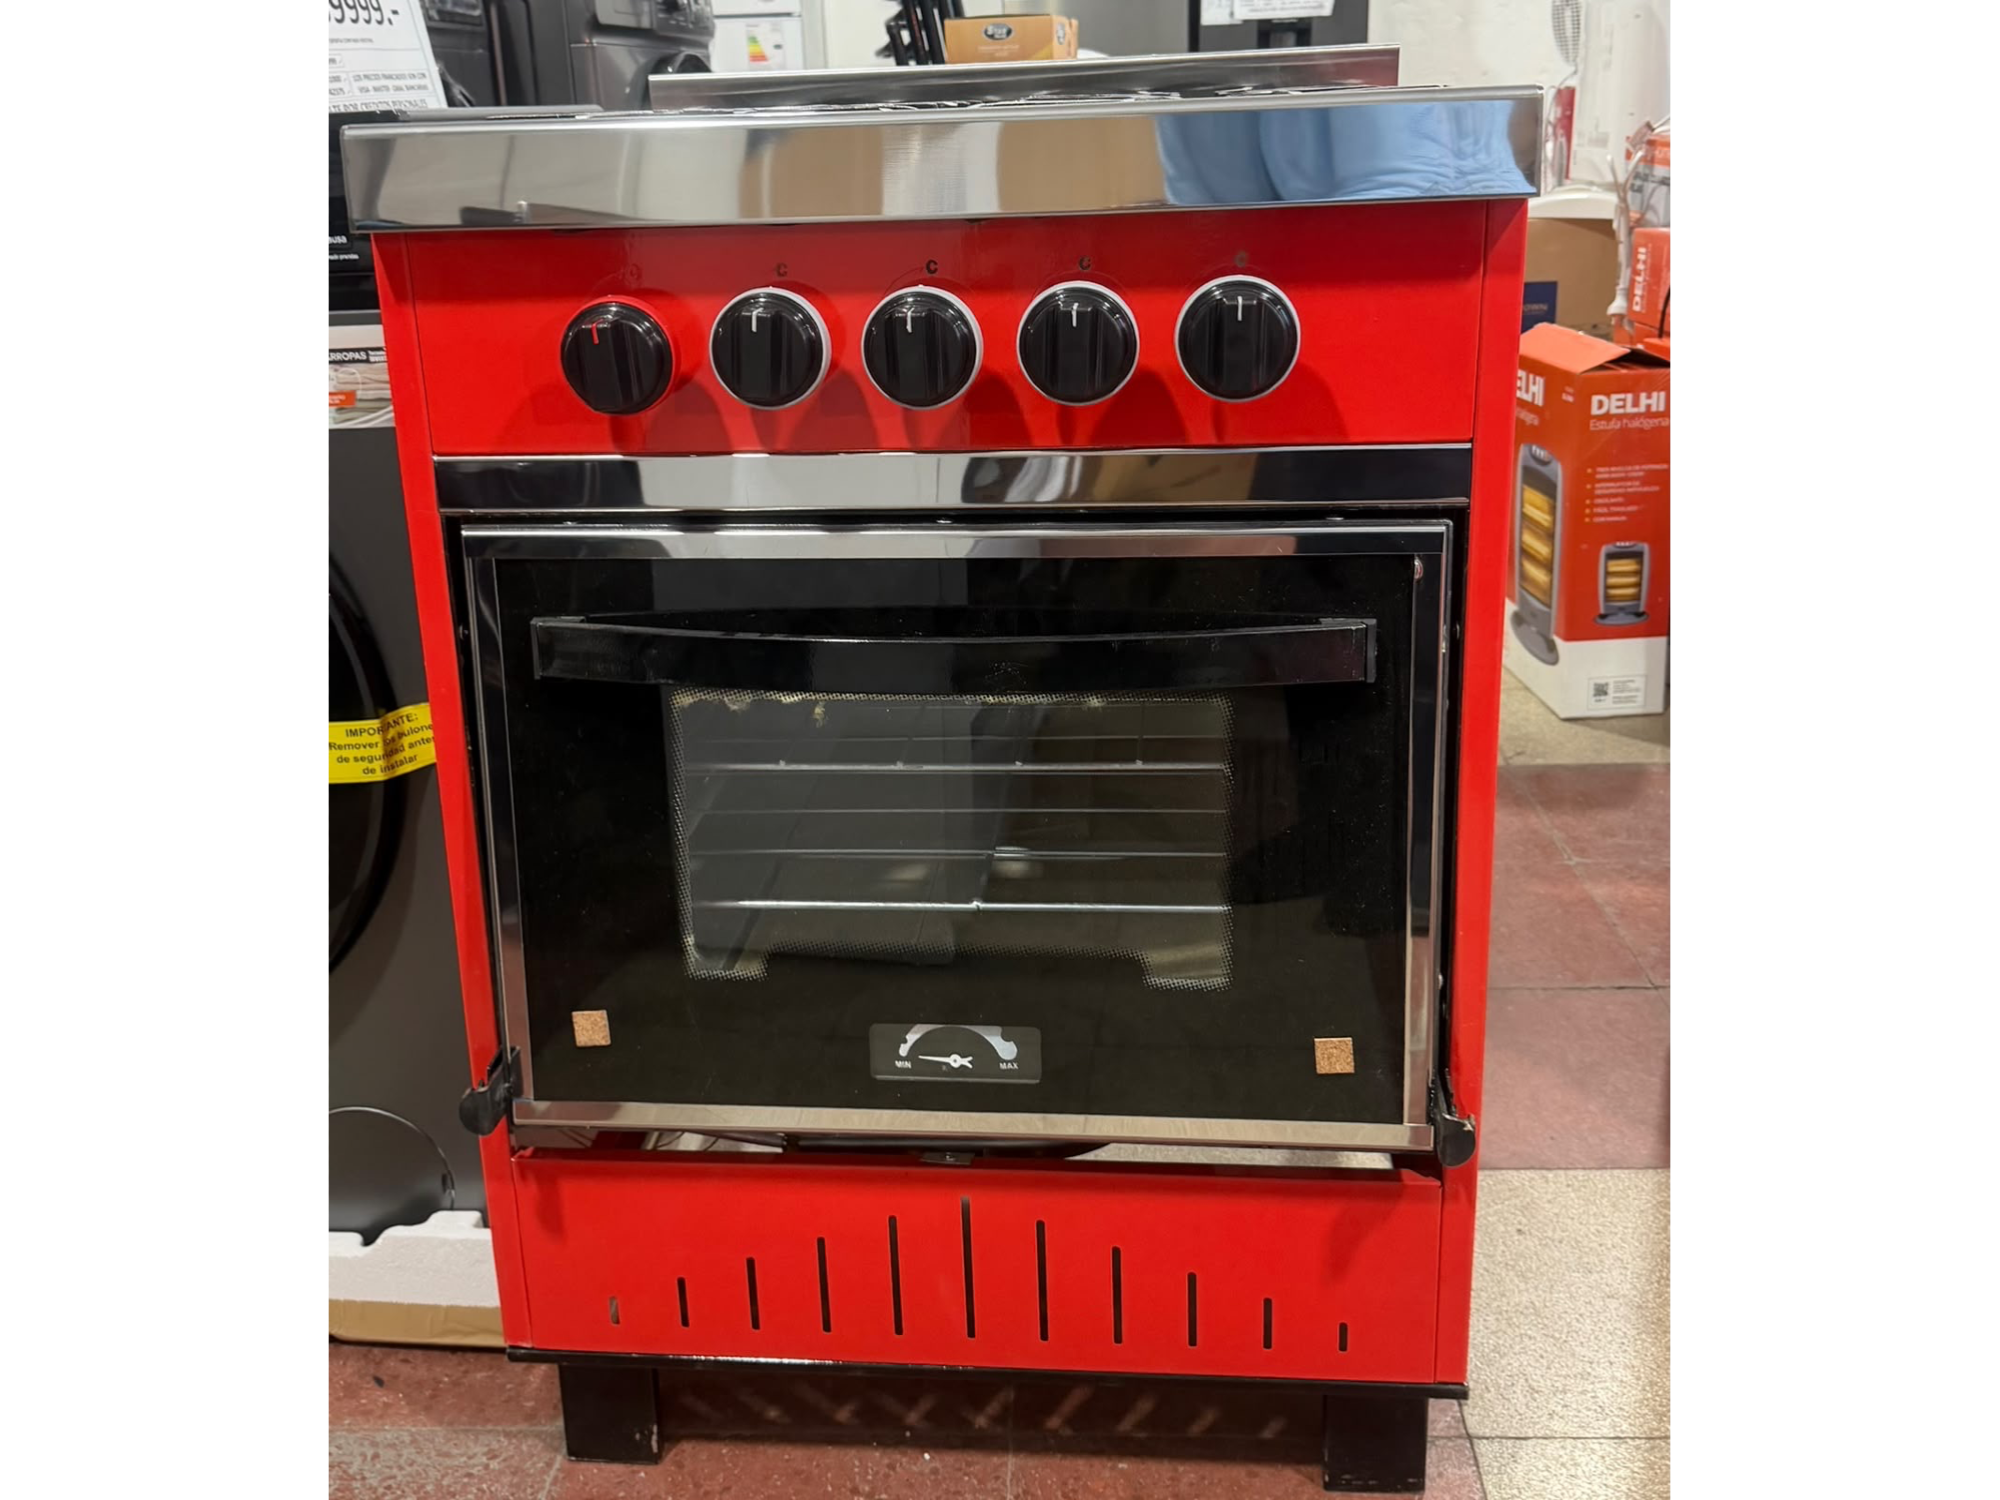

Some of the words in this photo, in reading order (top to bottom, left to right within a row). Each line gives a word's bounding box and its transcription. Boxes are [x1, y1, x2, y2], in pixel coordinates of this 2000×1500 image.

[328, 0, 399, 25] 9999.-
[925, 259, 938, 275] C
[1591, 391, 1666, 416] DELHI
[1590, 418, 1621, 431] Estufa
[1622, 415, 1670, 431] halógena
[345, 712, 418, 738] IMPORANTE:
[328, 741, 380, 750] Remover
[336, 755, 350, 763] de
[362, 766, 376, 775] de
[380, 754, 418, 773] instalar
[895, 1060, 912, 1069] MIN
[999, 1062, 1019, 1070] MAX
